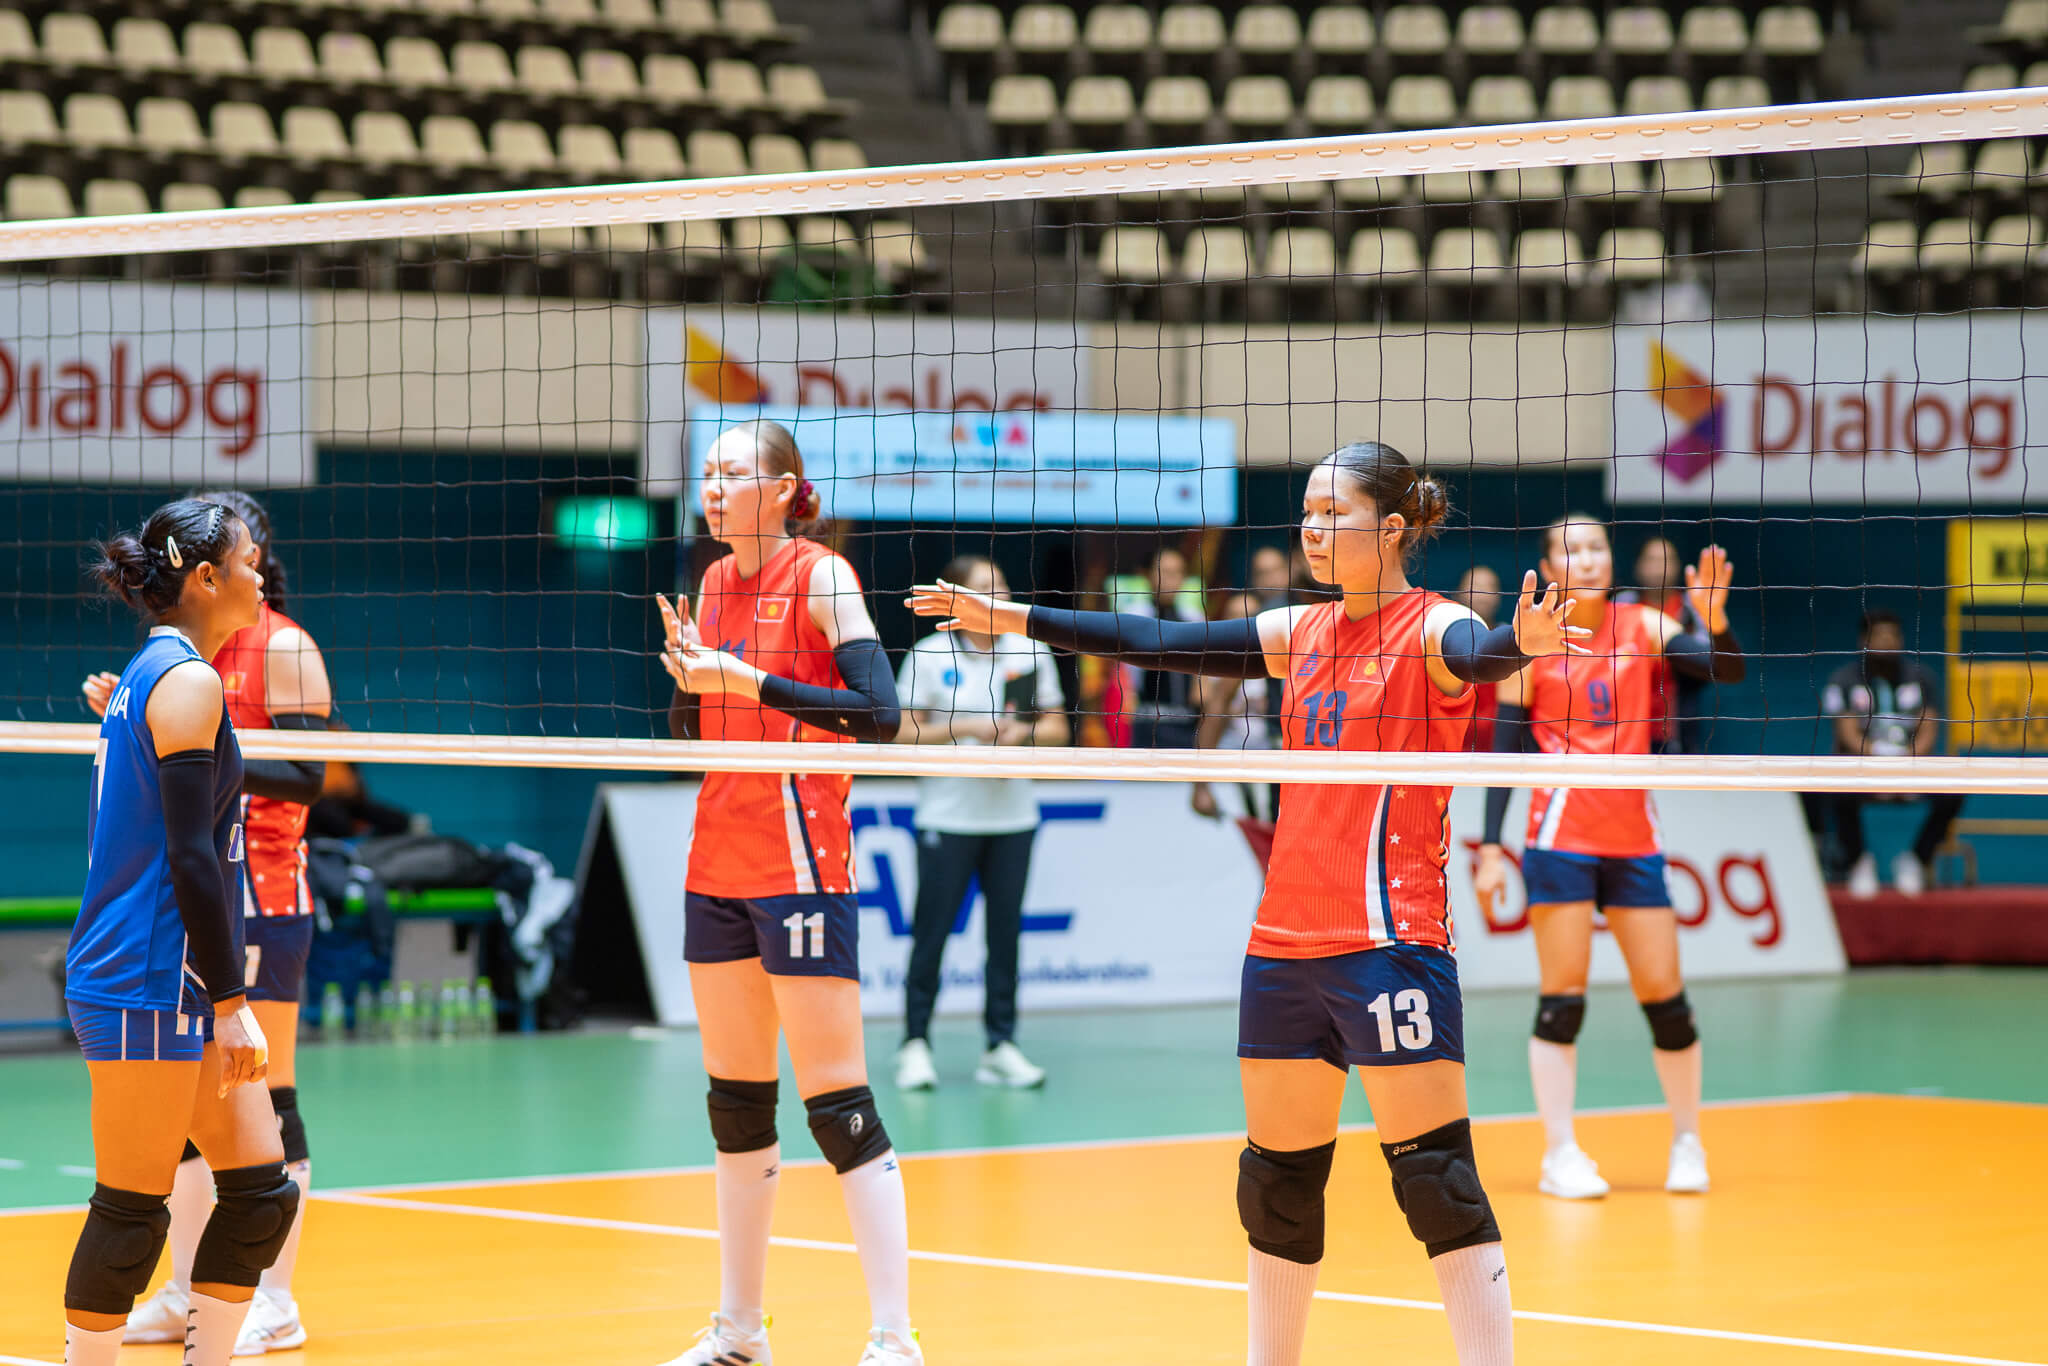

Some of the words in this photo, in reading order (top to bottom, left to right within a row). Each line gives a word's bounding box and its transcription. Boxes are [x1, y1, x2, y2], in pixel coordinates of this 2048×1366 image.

[0, 340, 261, 458] ialog
[1752, 373, 2013, 478] Dialog
[1303, 690, 1347, 747] 13
[1588, 680, 1611, 718] 9
[783, 912, 825, 958] 11
[1367, 988, 1433, 1053] 13
